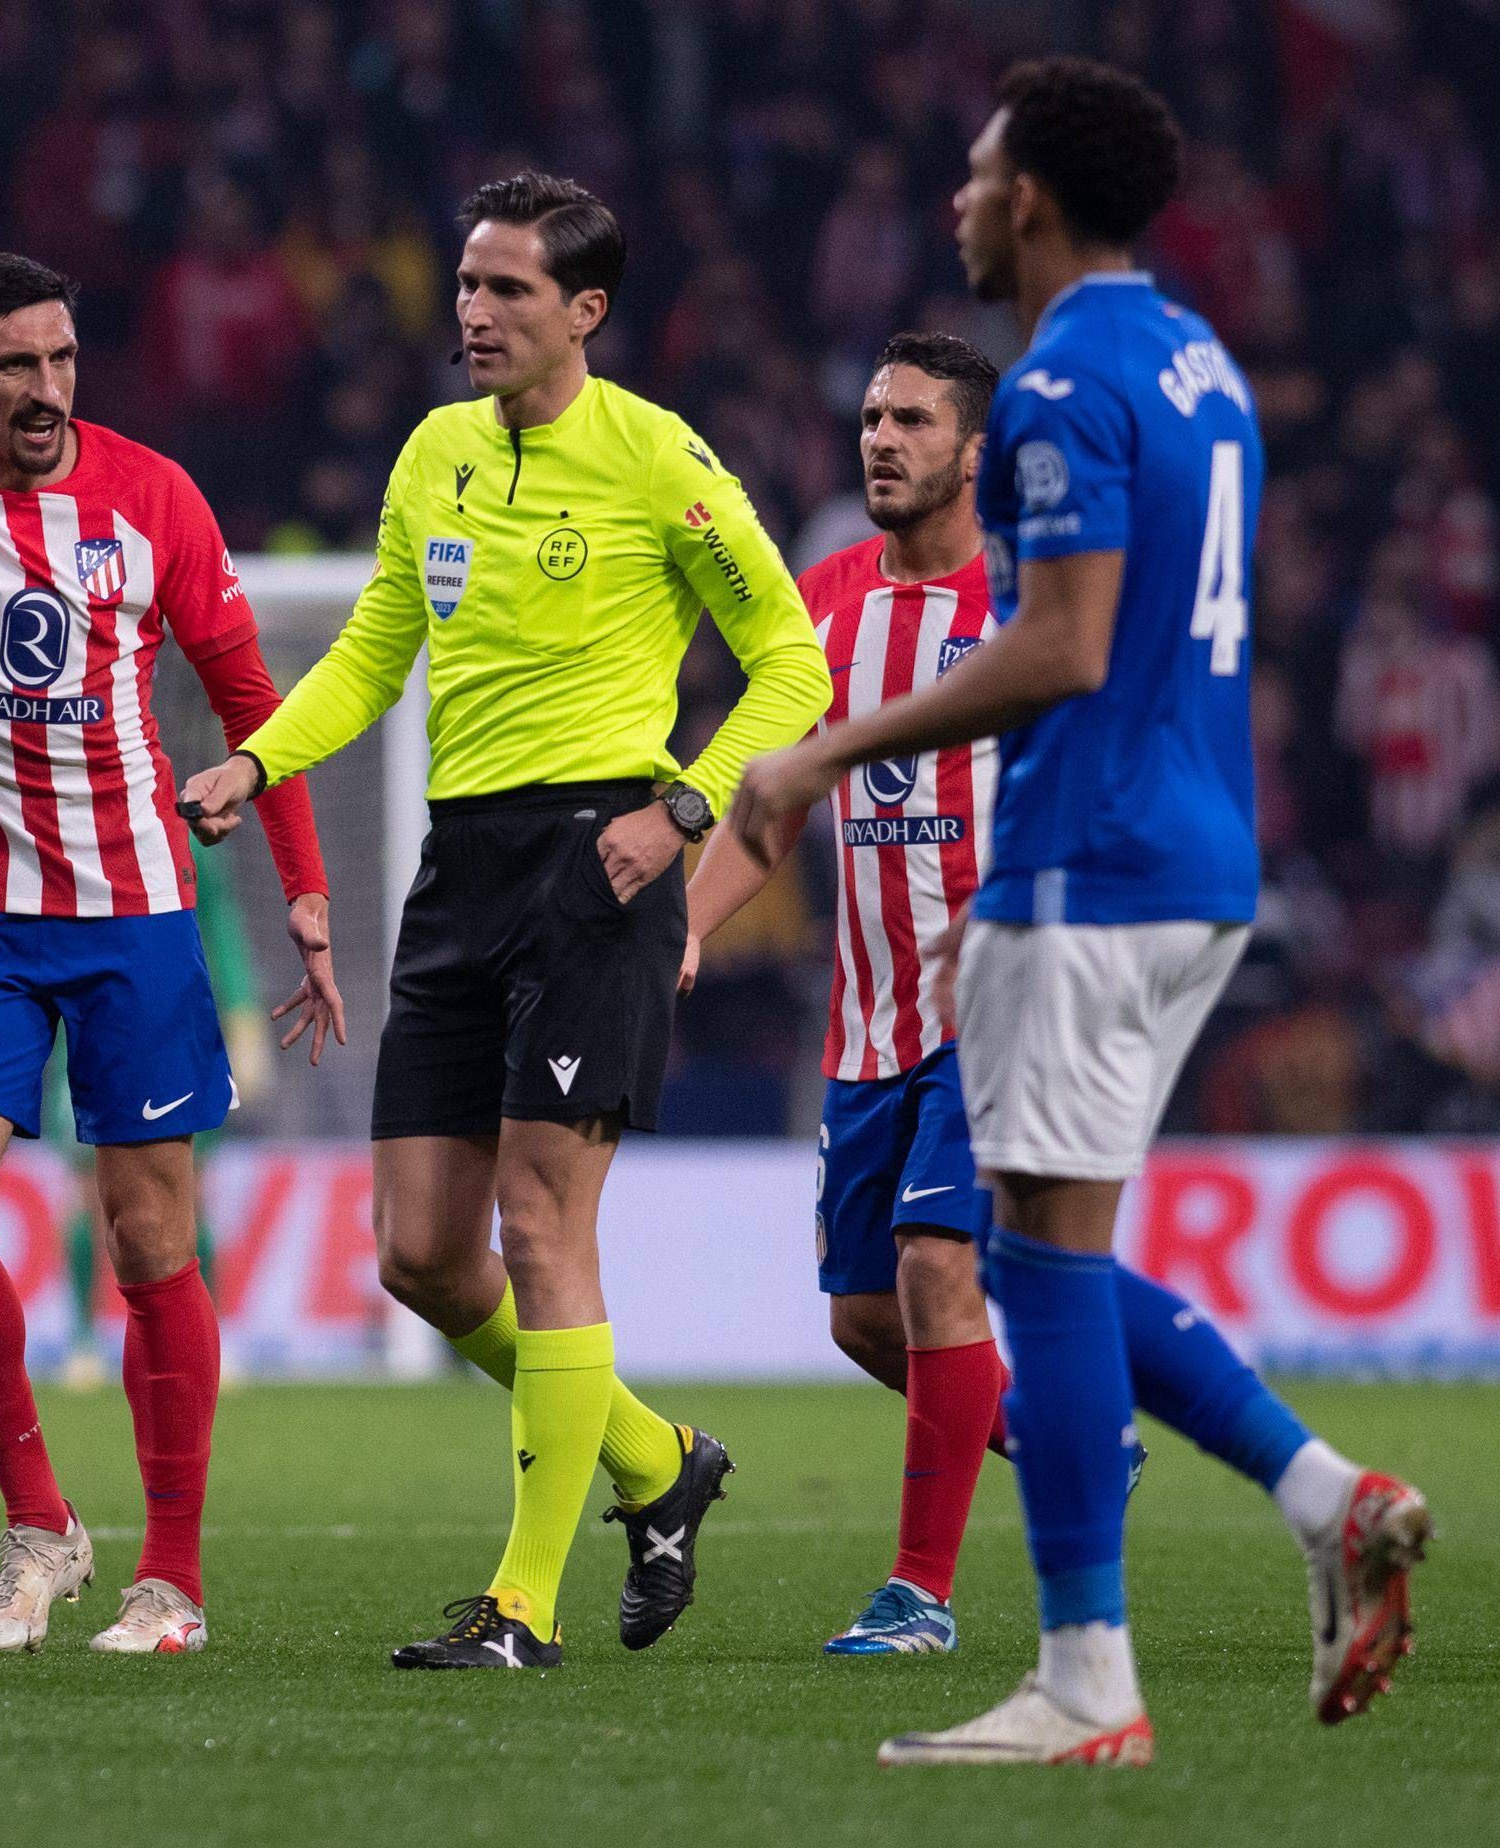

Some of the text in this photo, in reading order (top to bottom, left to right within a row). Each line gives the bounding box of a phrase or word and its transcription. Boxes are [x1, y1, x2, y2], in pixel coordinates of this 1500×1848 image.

[428, 542, 466, 563] FIFA
[1190, 440, 1249, 677] 4
[703, 527, 752, 602] WÜRTH
[427, 575, 463, 588] REFEREE
[435, 602, 451, 613] 2023
[58, 699, 100, 721] AIR
[844, 818, 959, 843] RIYADH AIR
